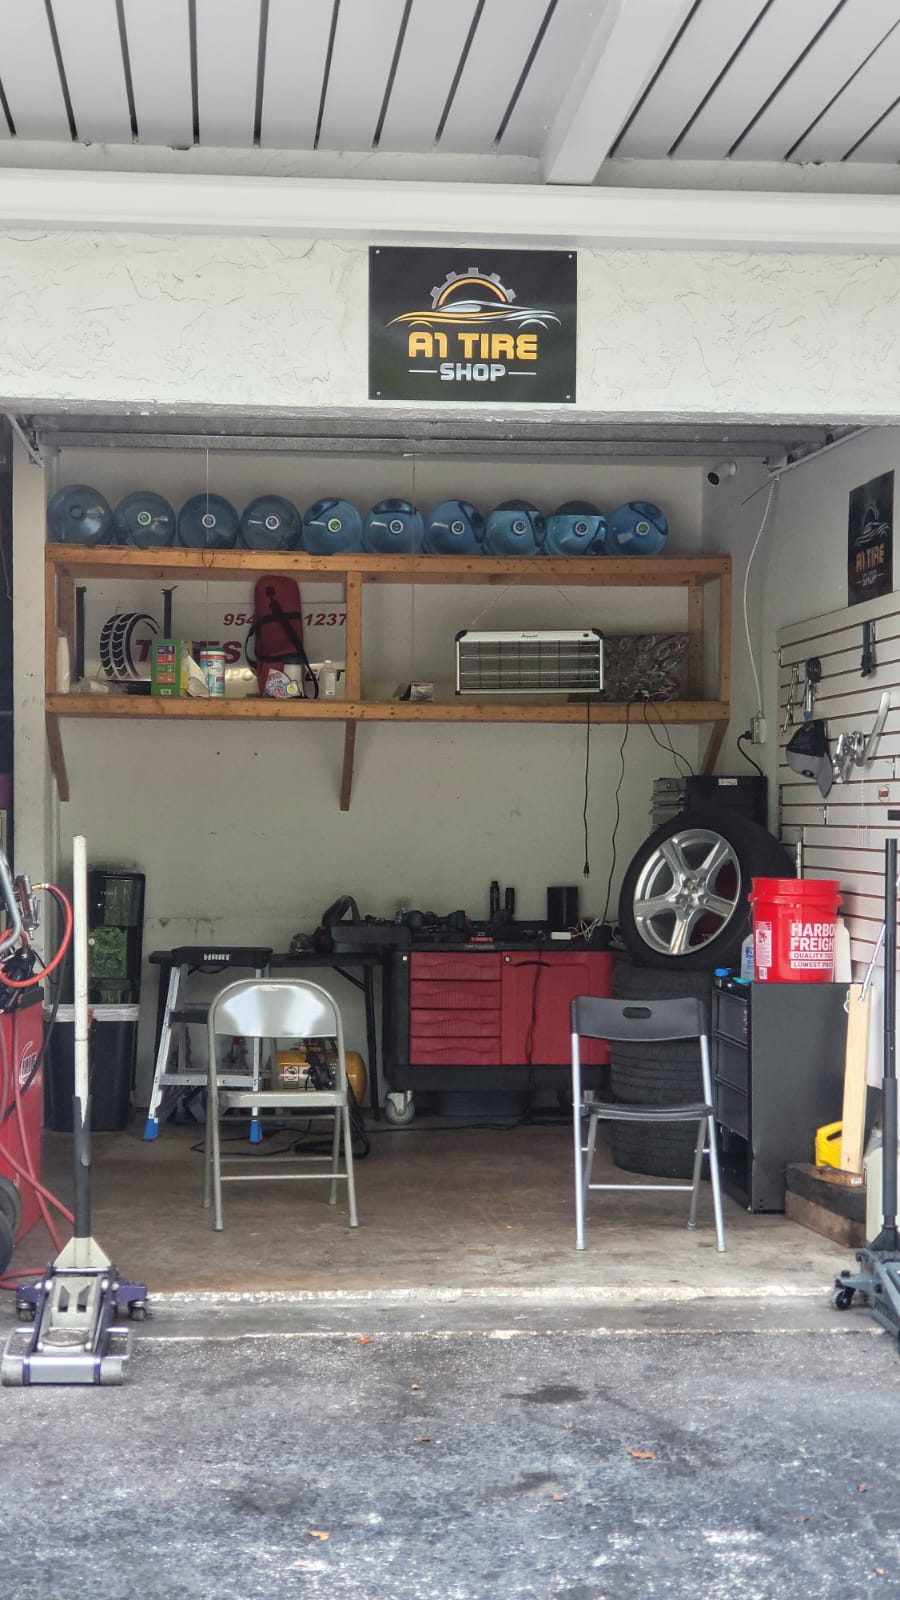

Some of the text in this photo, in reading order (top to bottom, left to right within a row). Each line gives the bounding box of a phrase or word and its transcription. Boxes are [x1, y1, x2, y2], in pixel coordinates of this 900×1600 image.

[408, 331, 538, 360] A1 TIRE
[439, 362, 506, 382] SHOP
[304, 613, 348, 626] 1237
[203, 953, 231, 961] HART
